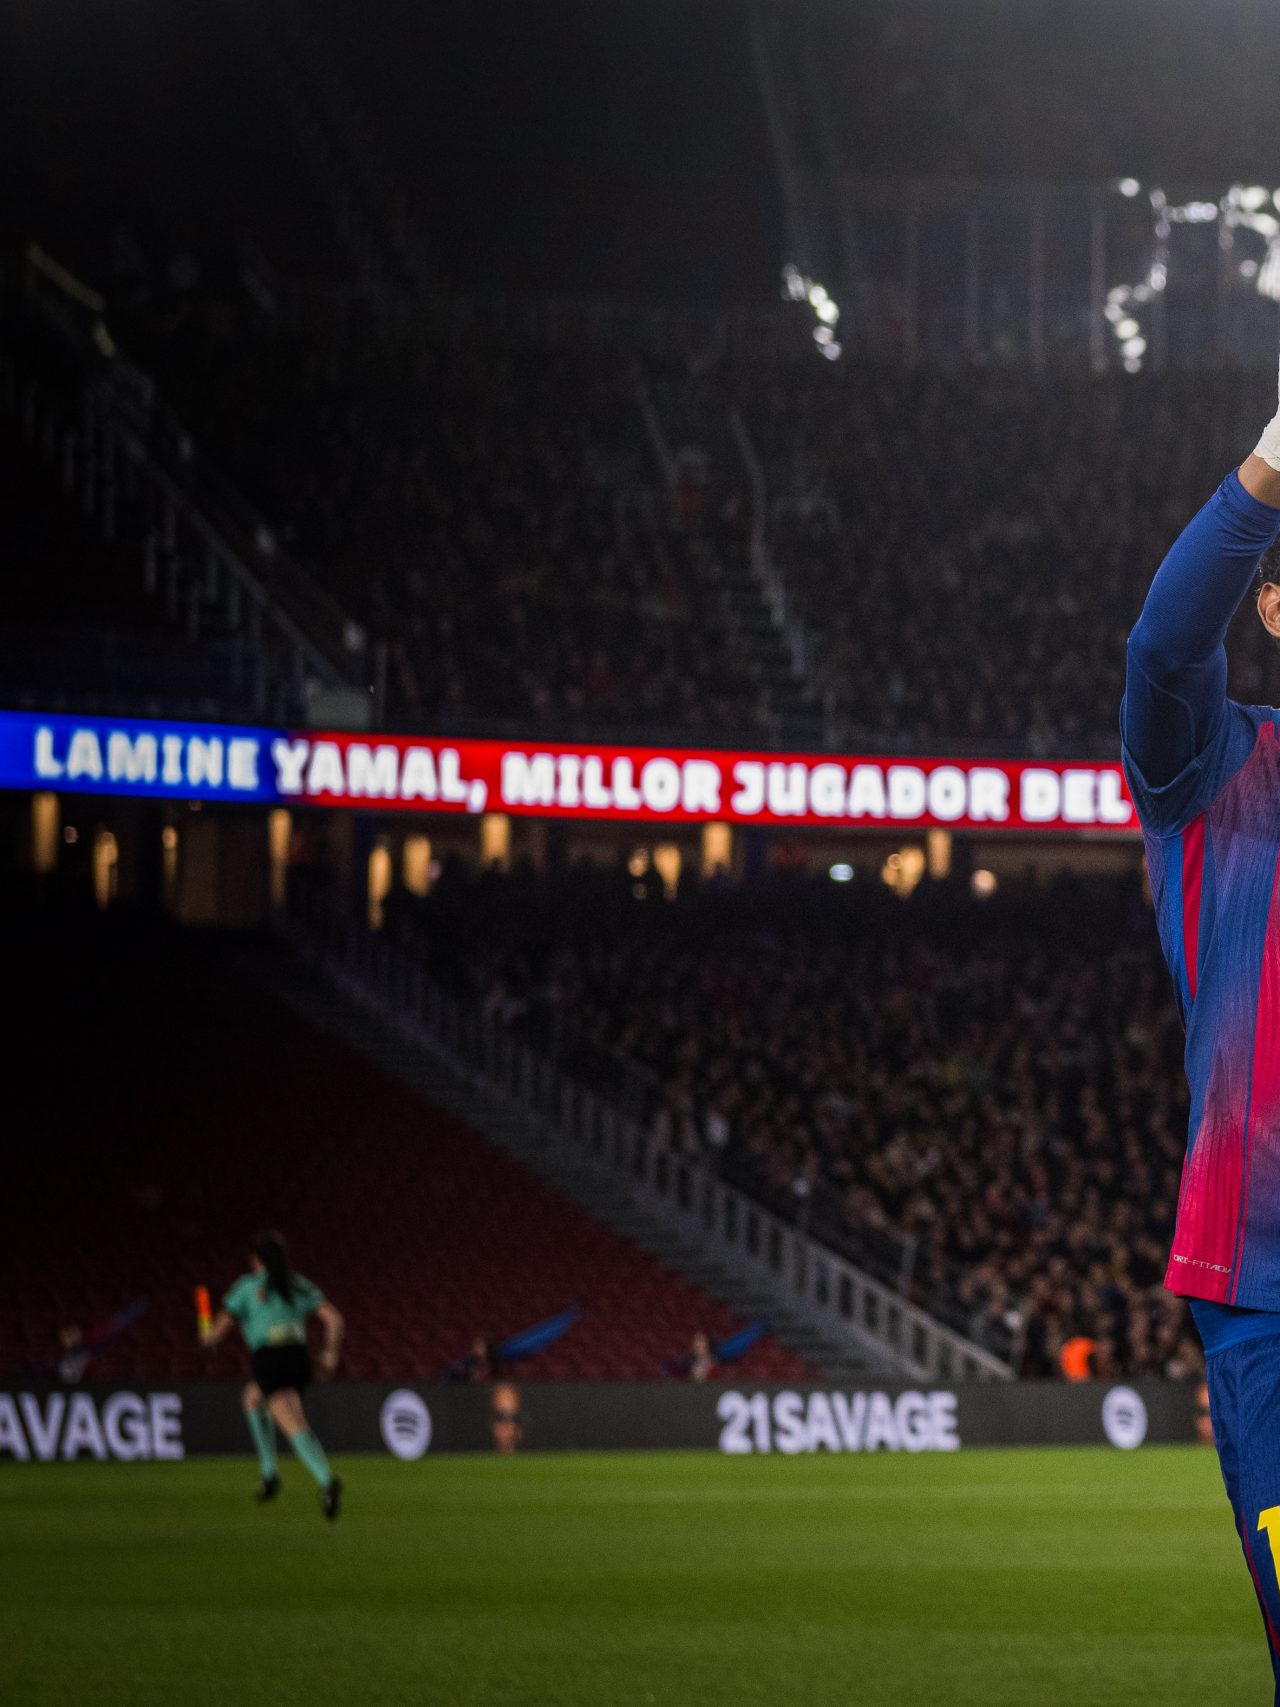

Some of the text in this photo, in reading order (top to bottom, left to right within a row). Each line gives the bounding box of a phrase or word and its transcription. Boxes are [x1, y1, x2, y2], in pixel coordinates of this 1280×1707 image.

[35, 727, 259, 790] LAMINE
[273, 740, 487, 812] YAMAL,
[501, 752, 721, 813] MILLOR
[732, 761, 1009, 821] JUGADOR
[1020, 768, 1132, 824] DEL
